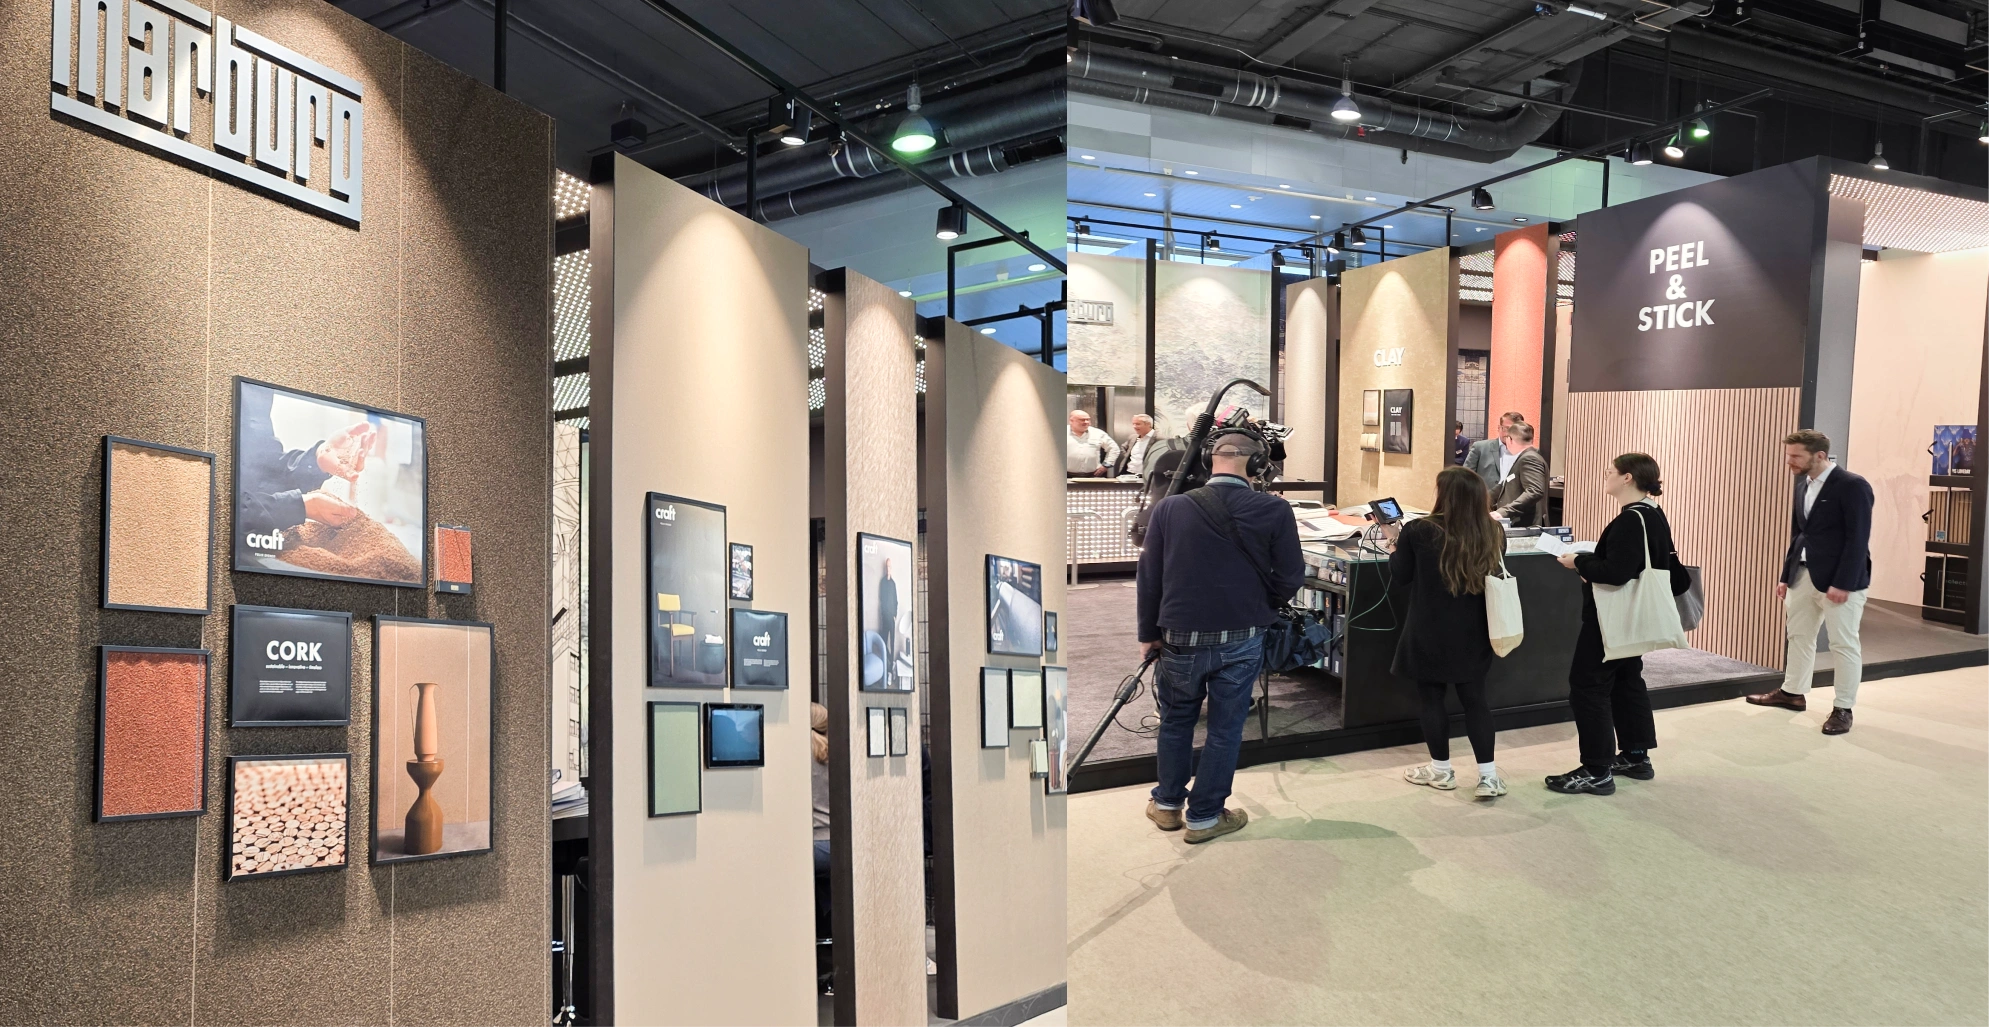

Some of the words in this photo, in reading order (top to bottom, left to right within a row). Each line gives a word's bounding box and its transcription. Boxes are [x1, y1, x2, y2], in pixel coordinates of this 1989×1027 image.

[1649, 241, 1709, 274] PEEL
[1665, 274, 1687, 300] &
[1637, 299, 1715, 331] STICK
[1373, 347, 1405, 367] CLAY
[655, 505, 676, 521] craft
[247, 528, 284, 550] craft
[864, 541, 878, 555] craft
[753, 631, 770, 647] craft
[992, 629, 1004, 641] craft
[266, 640, 322, 661] CORK
